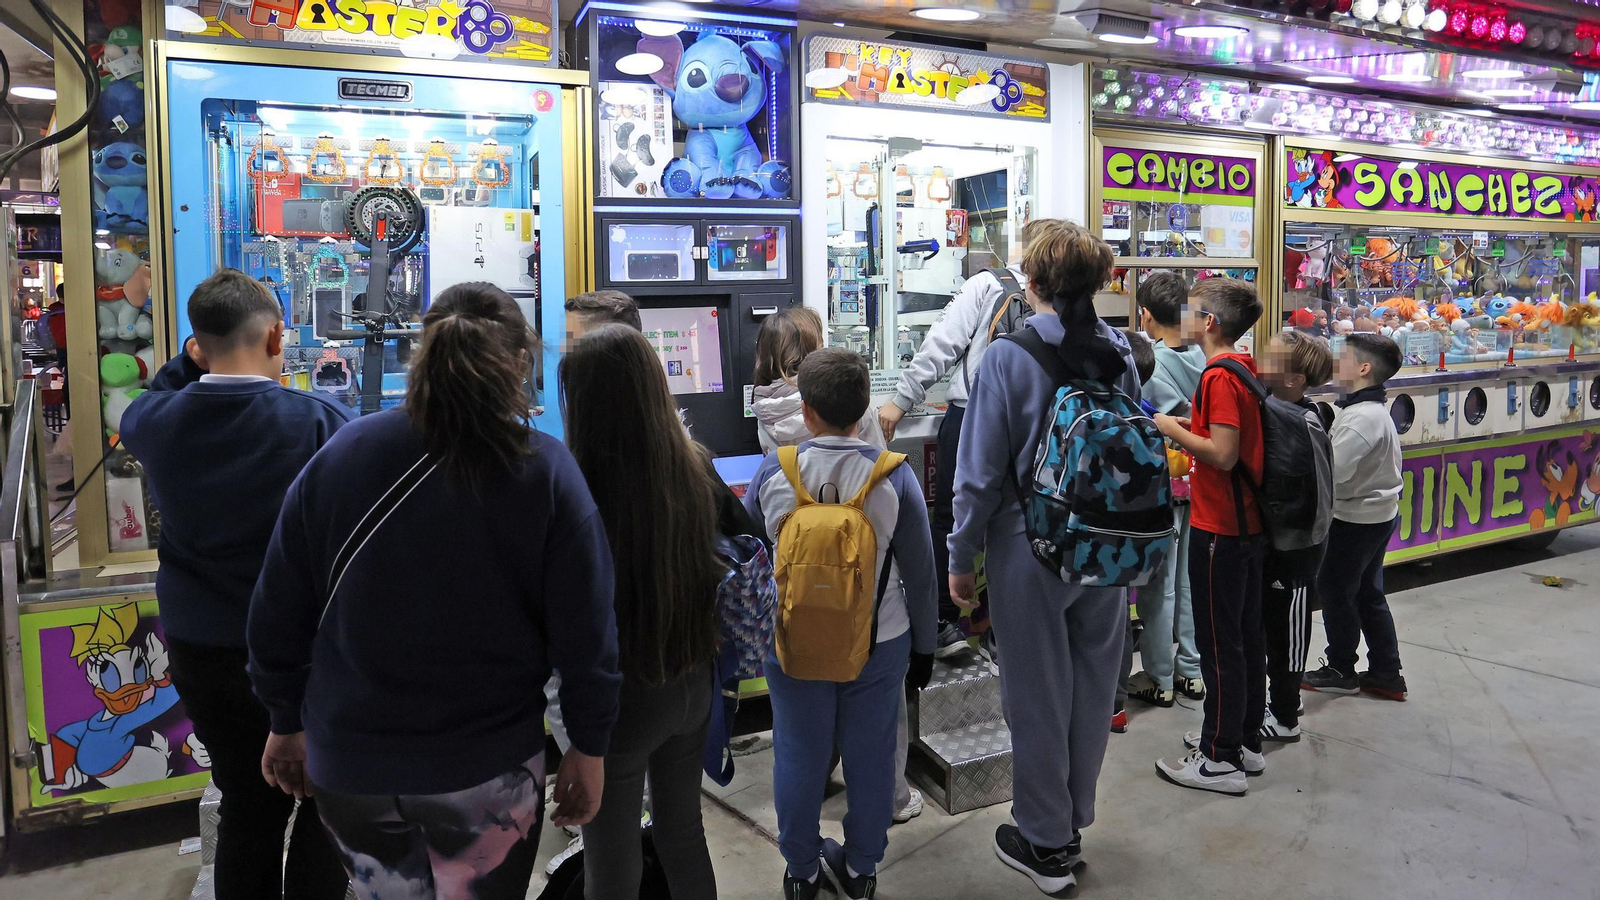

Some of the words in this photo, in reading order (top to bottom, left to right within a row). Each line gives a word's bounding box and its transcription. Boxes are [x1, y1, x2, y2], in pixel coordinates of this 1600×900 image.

[859, 43, 912, 67] KEY
[1107, 152, 1250, 192] CAMBIO
[1229, 210, 1250, 223] VISA
[475, 222, 483, 252] PS5
[21, 265, 31, 276] 6
[1398, 454, 1526, 541] HINE
